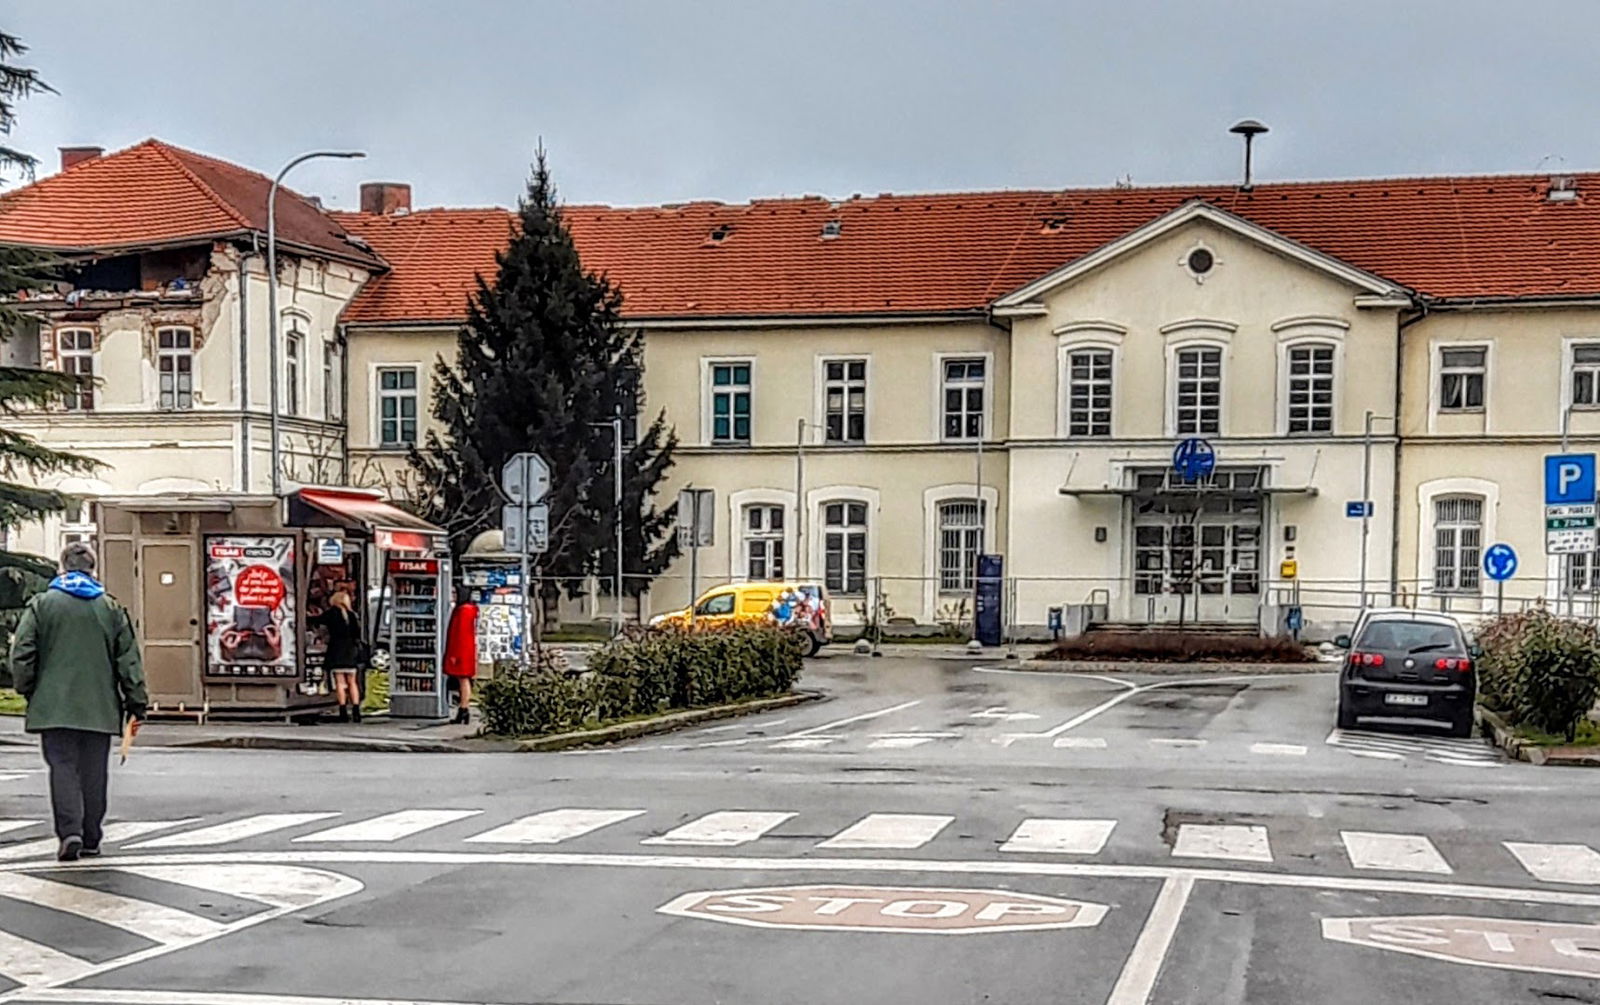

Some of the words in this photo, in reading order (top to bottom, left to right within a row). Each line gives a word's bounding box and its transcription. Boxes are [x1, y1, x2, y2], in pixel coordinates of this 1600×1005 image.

[1559, 463, 1582, 495] P
[399, 562, 427, 570] TISAK
[704, 896, 1065, 920] STOP
